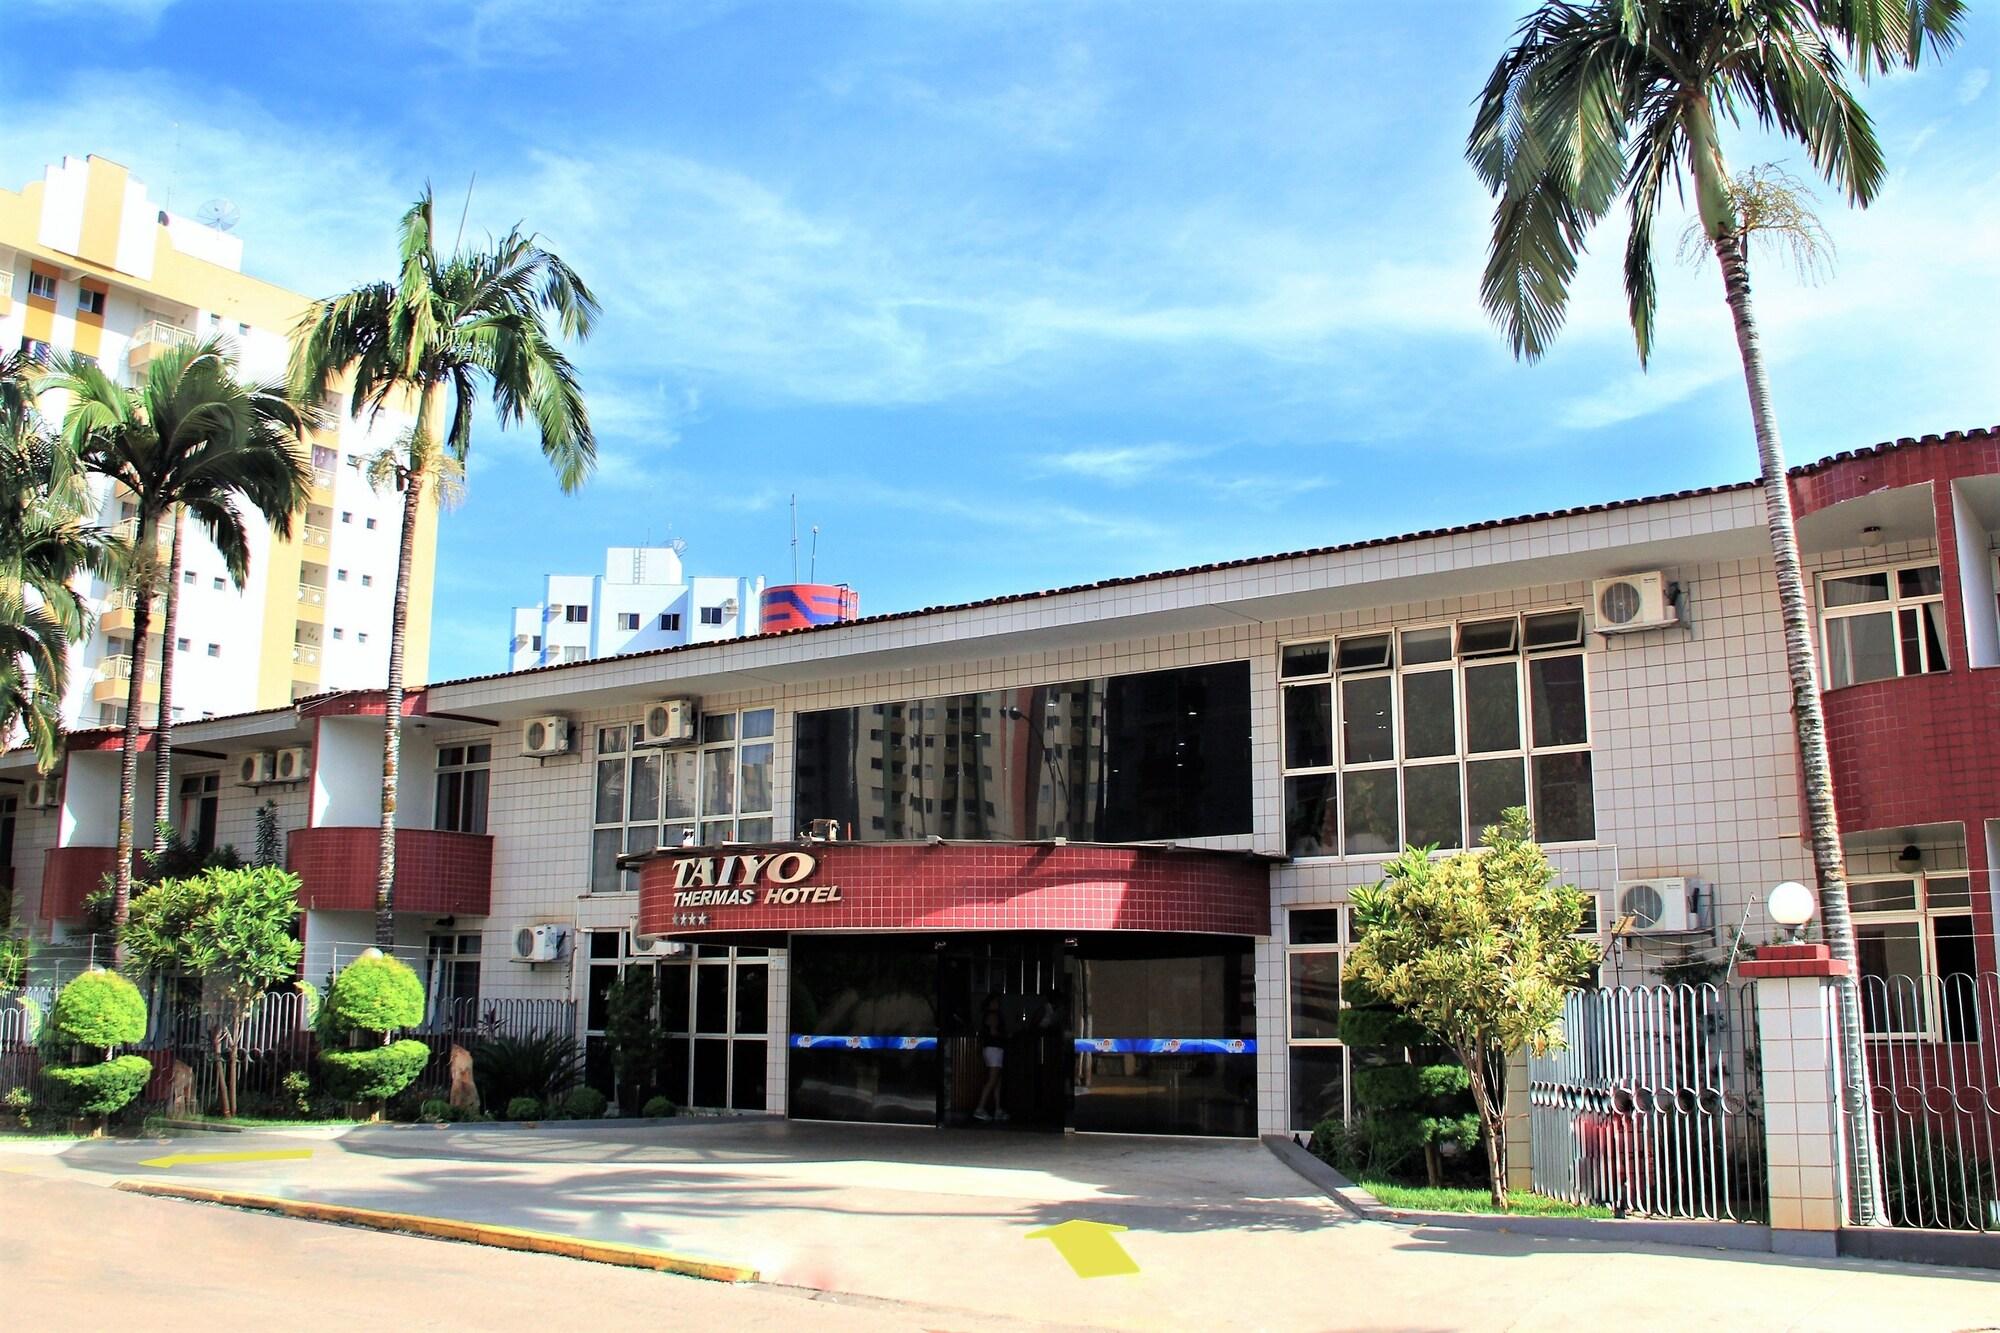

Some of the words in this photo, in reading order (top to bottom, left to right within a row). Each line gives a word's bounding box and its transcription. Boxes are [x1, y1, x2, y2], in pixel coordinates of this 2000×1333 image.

[672, 852, 816, 889] TAIYO
[673, 889, 755, 908] THERMAS
[763, 885, 842, 905] HOTEL
